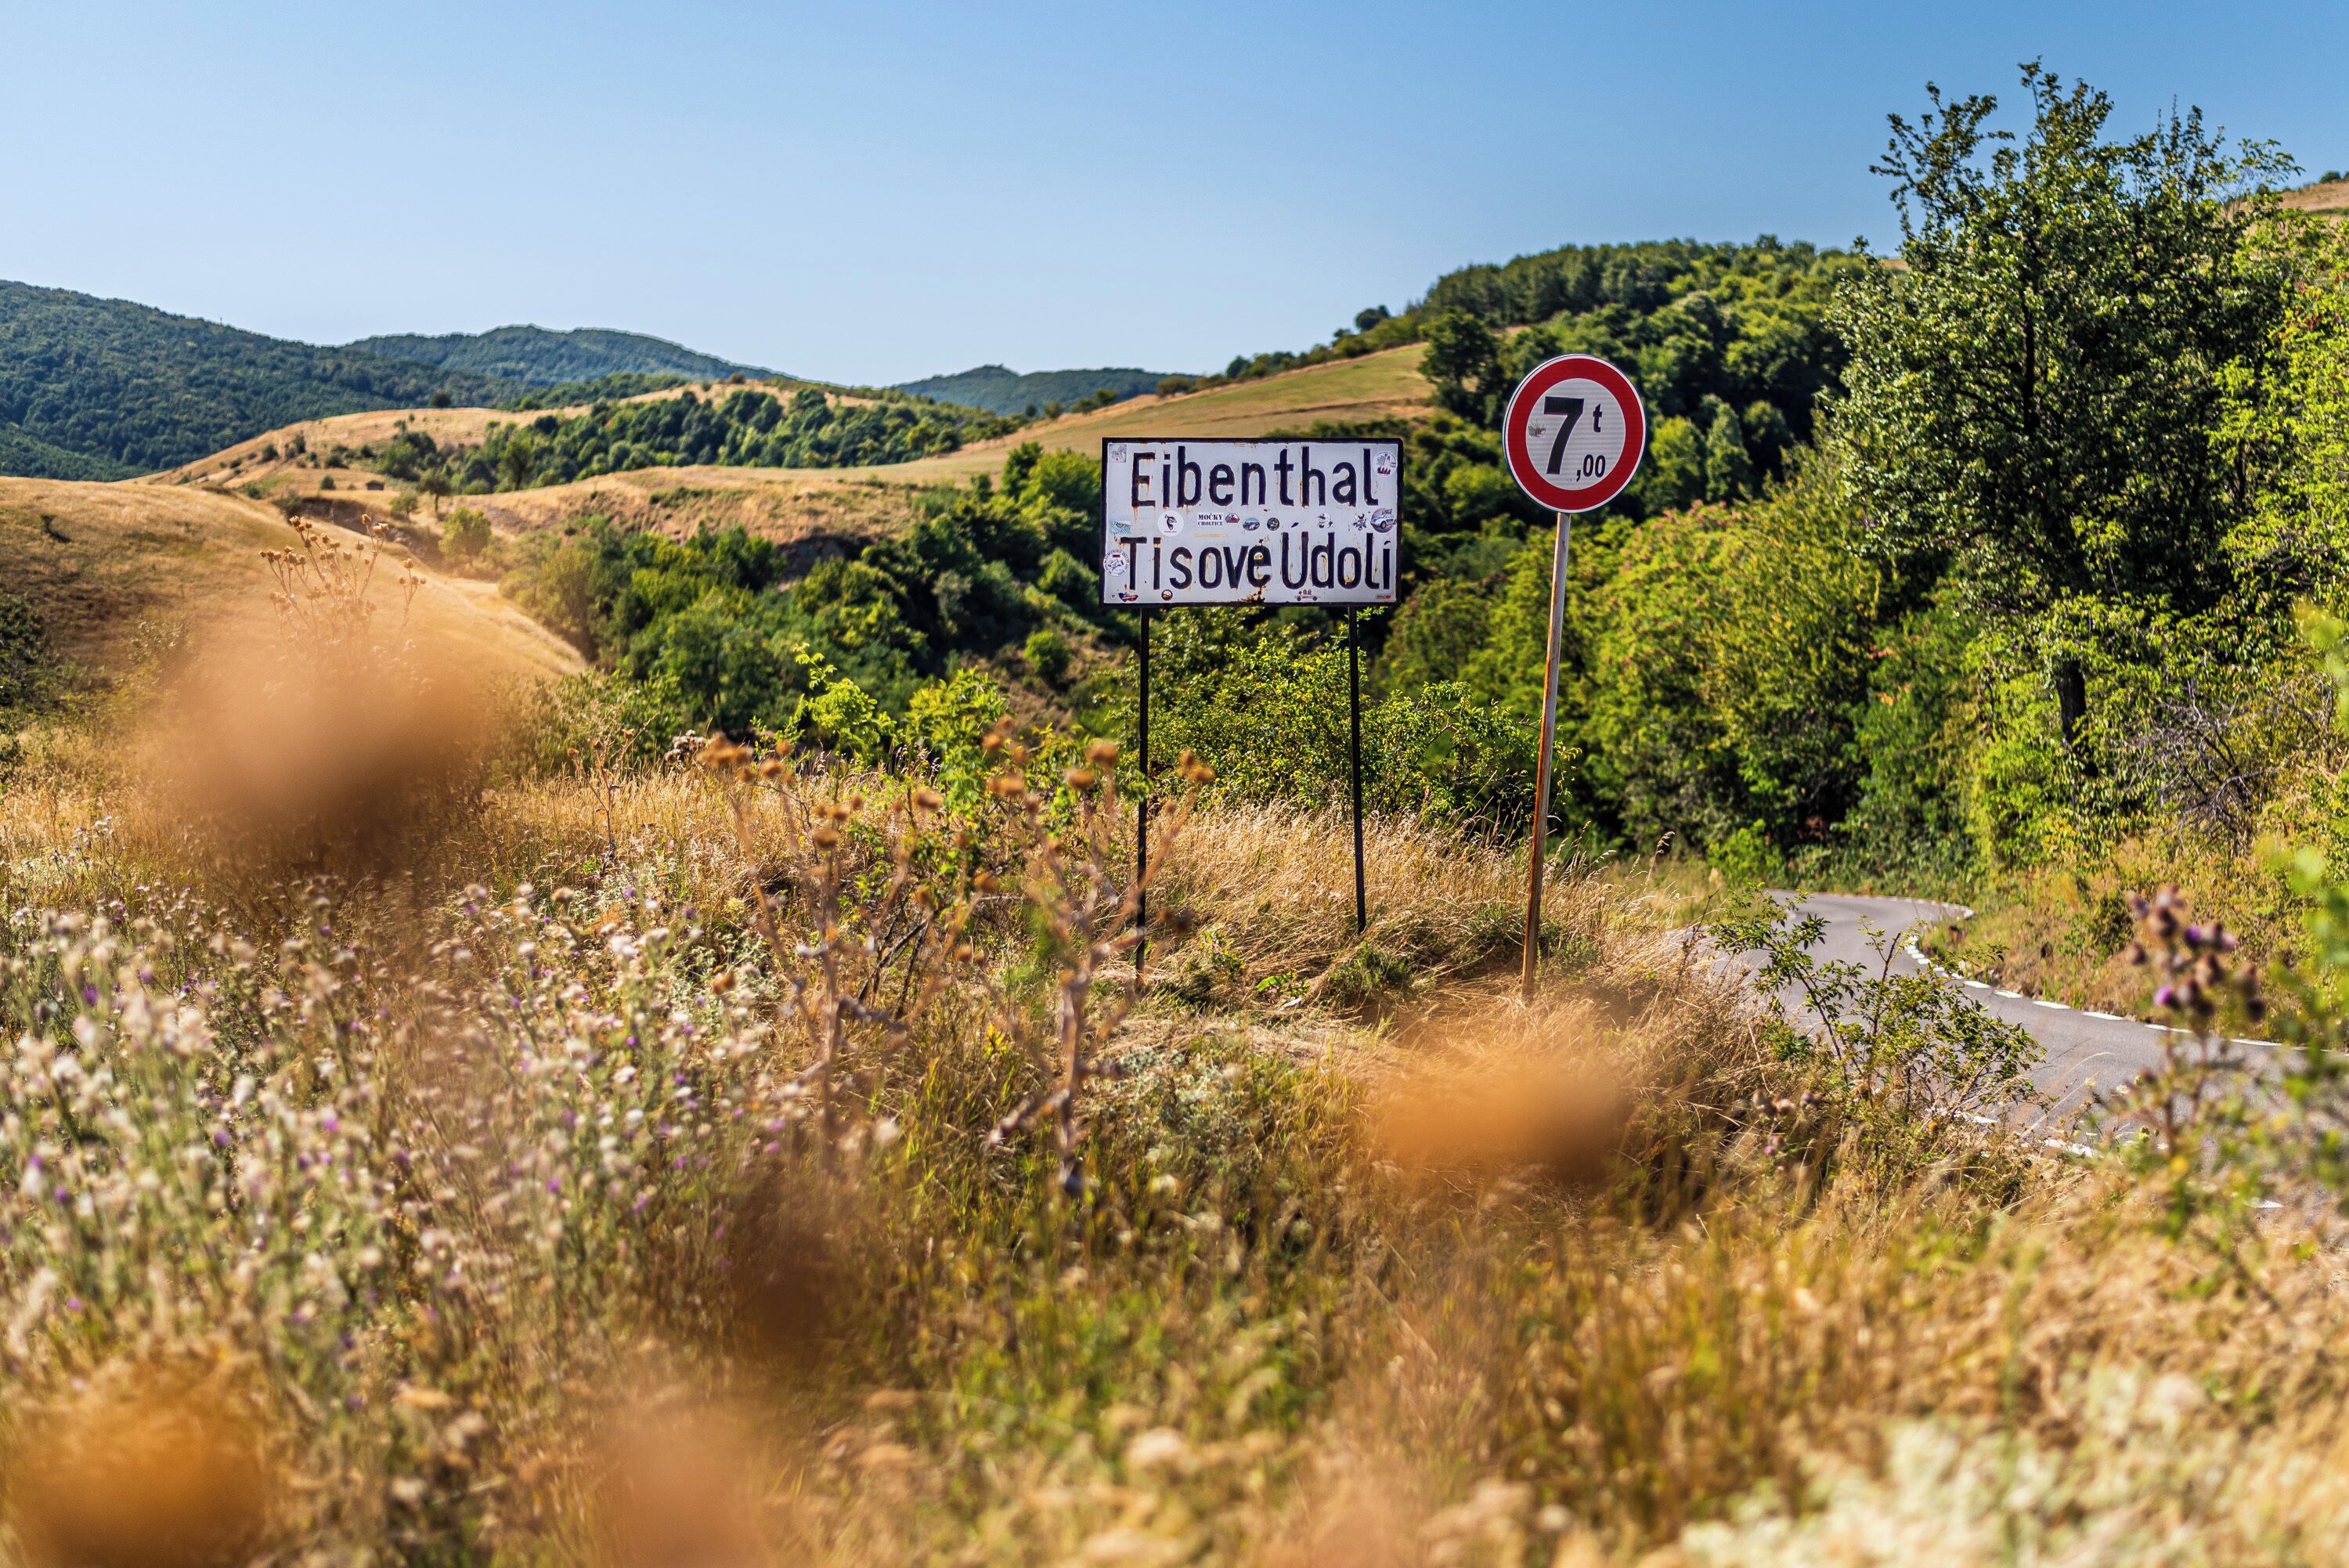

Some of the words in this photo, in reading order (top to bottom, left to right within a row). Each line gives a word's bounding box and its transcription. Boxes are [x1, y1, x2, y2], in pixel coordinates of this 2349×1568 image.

[1543, 396, 1585, 474] 7
[1593, 403, 1603, 432] t
[1131, 445, 1380, 507] Eibenthal
